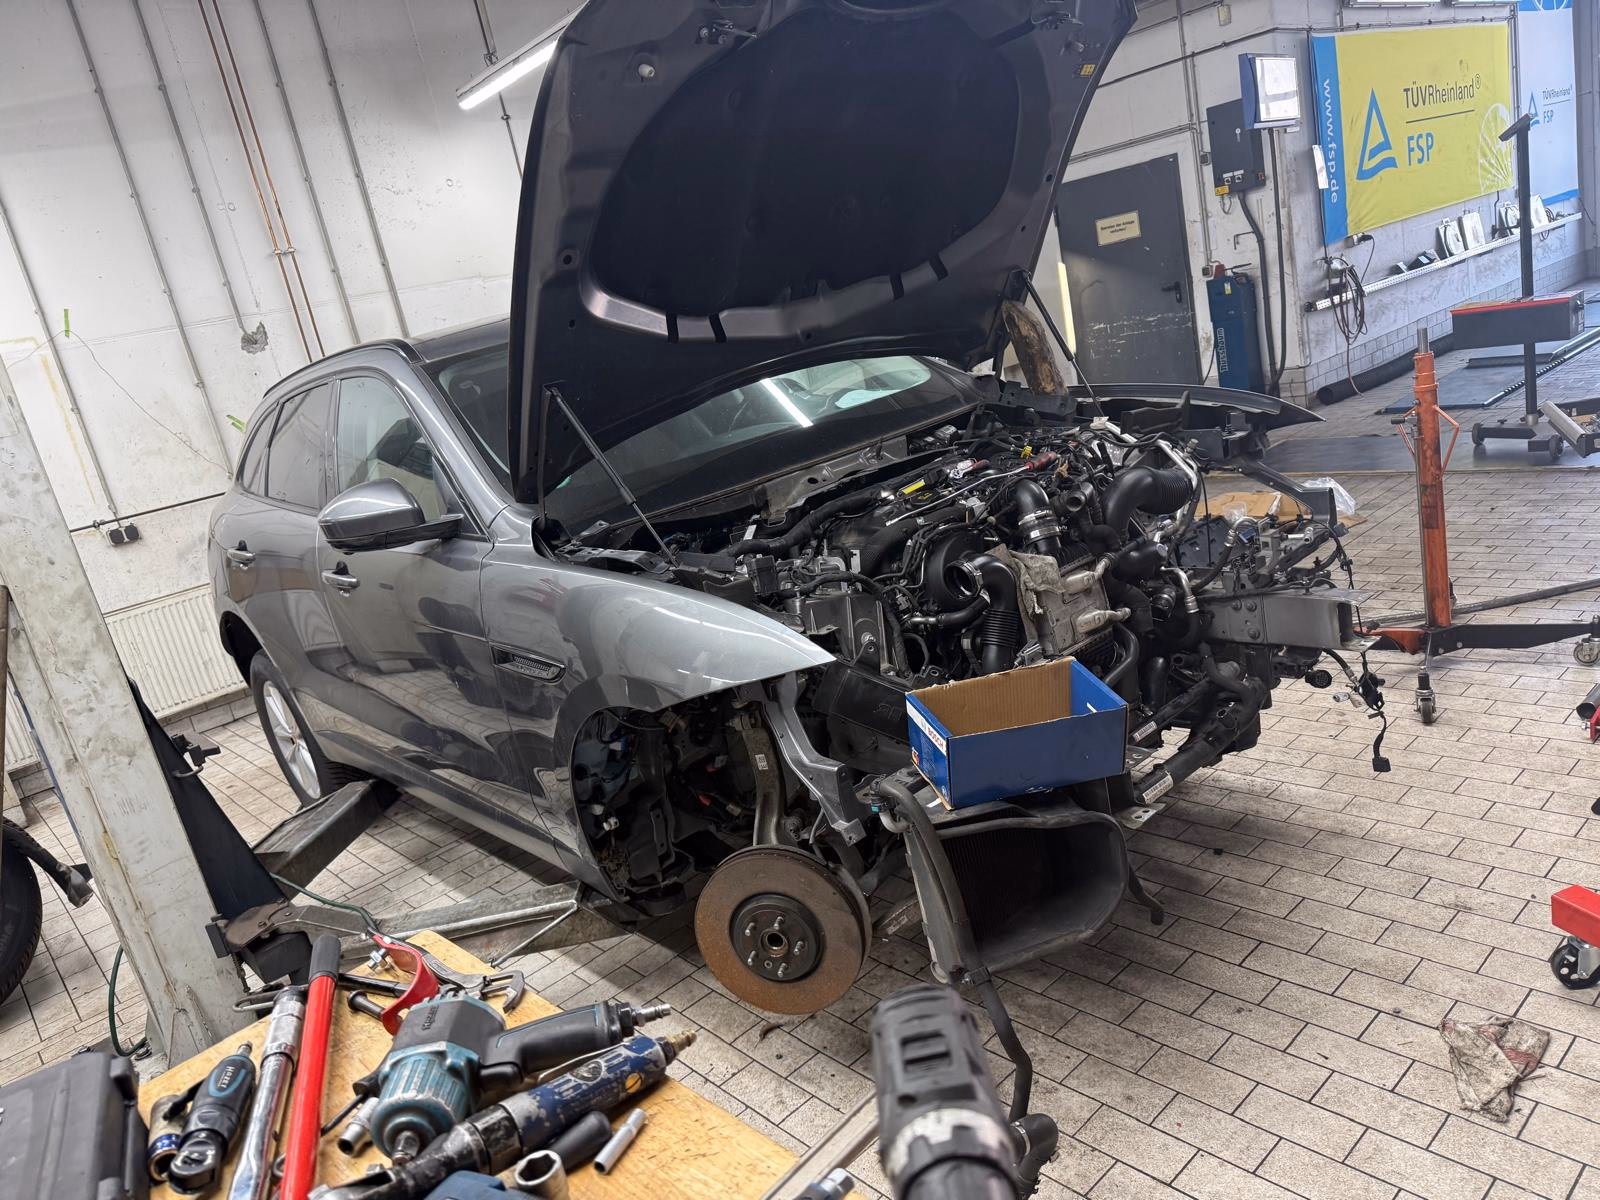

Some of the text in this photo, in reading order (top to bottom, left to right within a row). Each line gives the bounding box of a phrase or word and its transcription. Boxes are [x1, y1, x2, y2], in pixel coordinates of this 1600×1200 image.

[1543, 109, 1554, 124] FSP
[1323, 79, 1340, 203] www.fsp.de
[1407, 132, 1434, 167] FSP
[927, 725, 945, 750] BOSCH
